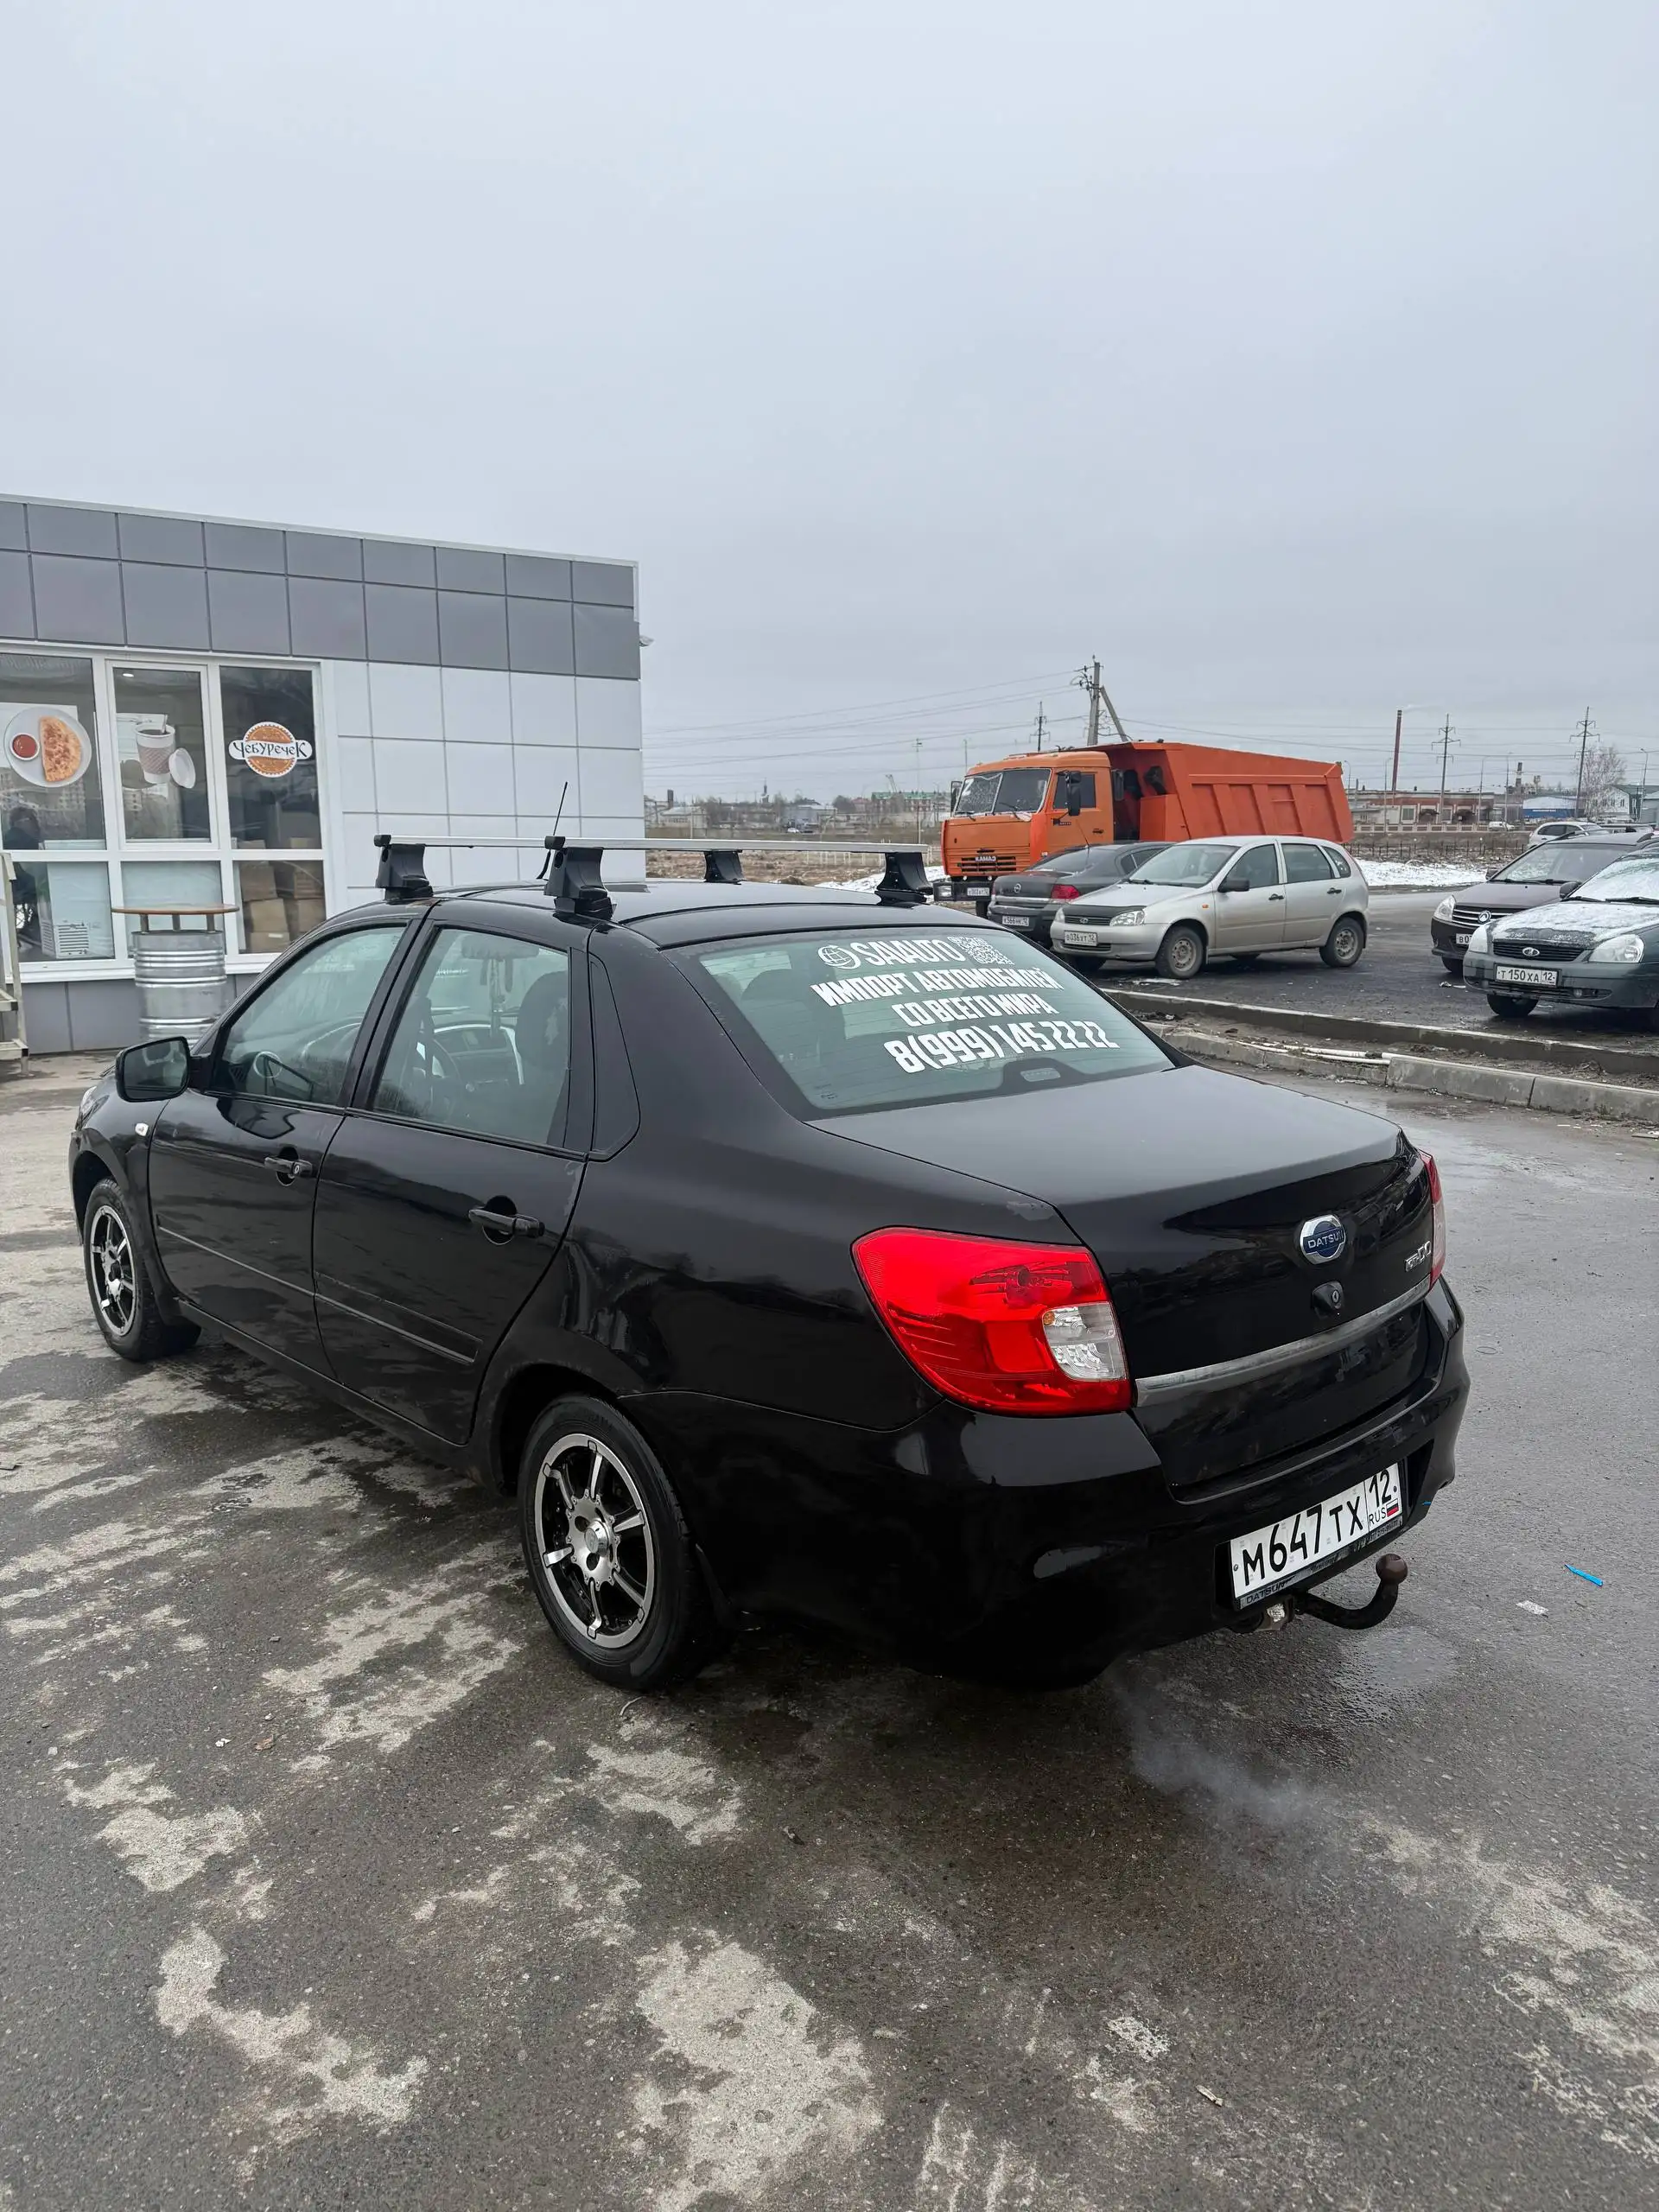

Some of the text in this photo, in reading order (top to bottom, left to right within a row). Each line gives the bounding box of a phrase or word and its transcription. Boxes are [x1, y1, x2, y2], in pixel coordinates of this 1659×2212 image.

[1459, 935, 1472, 944] В0
[810, 966, 1065, 1007] ИМПОРТ АВТОМОБИЛЕЙ
[1542, 971, 1553, 982] 12
[891, 993, 1059, 1027] СО ВСЕГО МИРА
[884, 1025, 1005, 1073] 8(999)
[1307, 1230, 1344, 1249] DATSUN
[1242, 1469, 1392, 1586] М647ТХ 12
[1369, 1506, 1387, 1526] RUS
[1246, 1580, 1286, 1605] DATSUN
